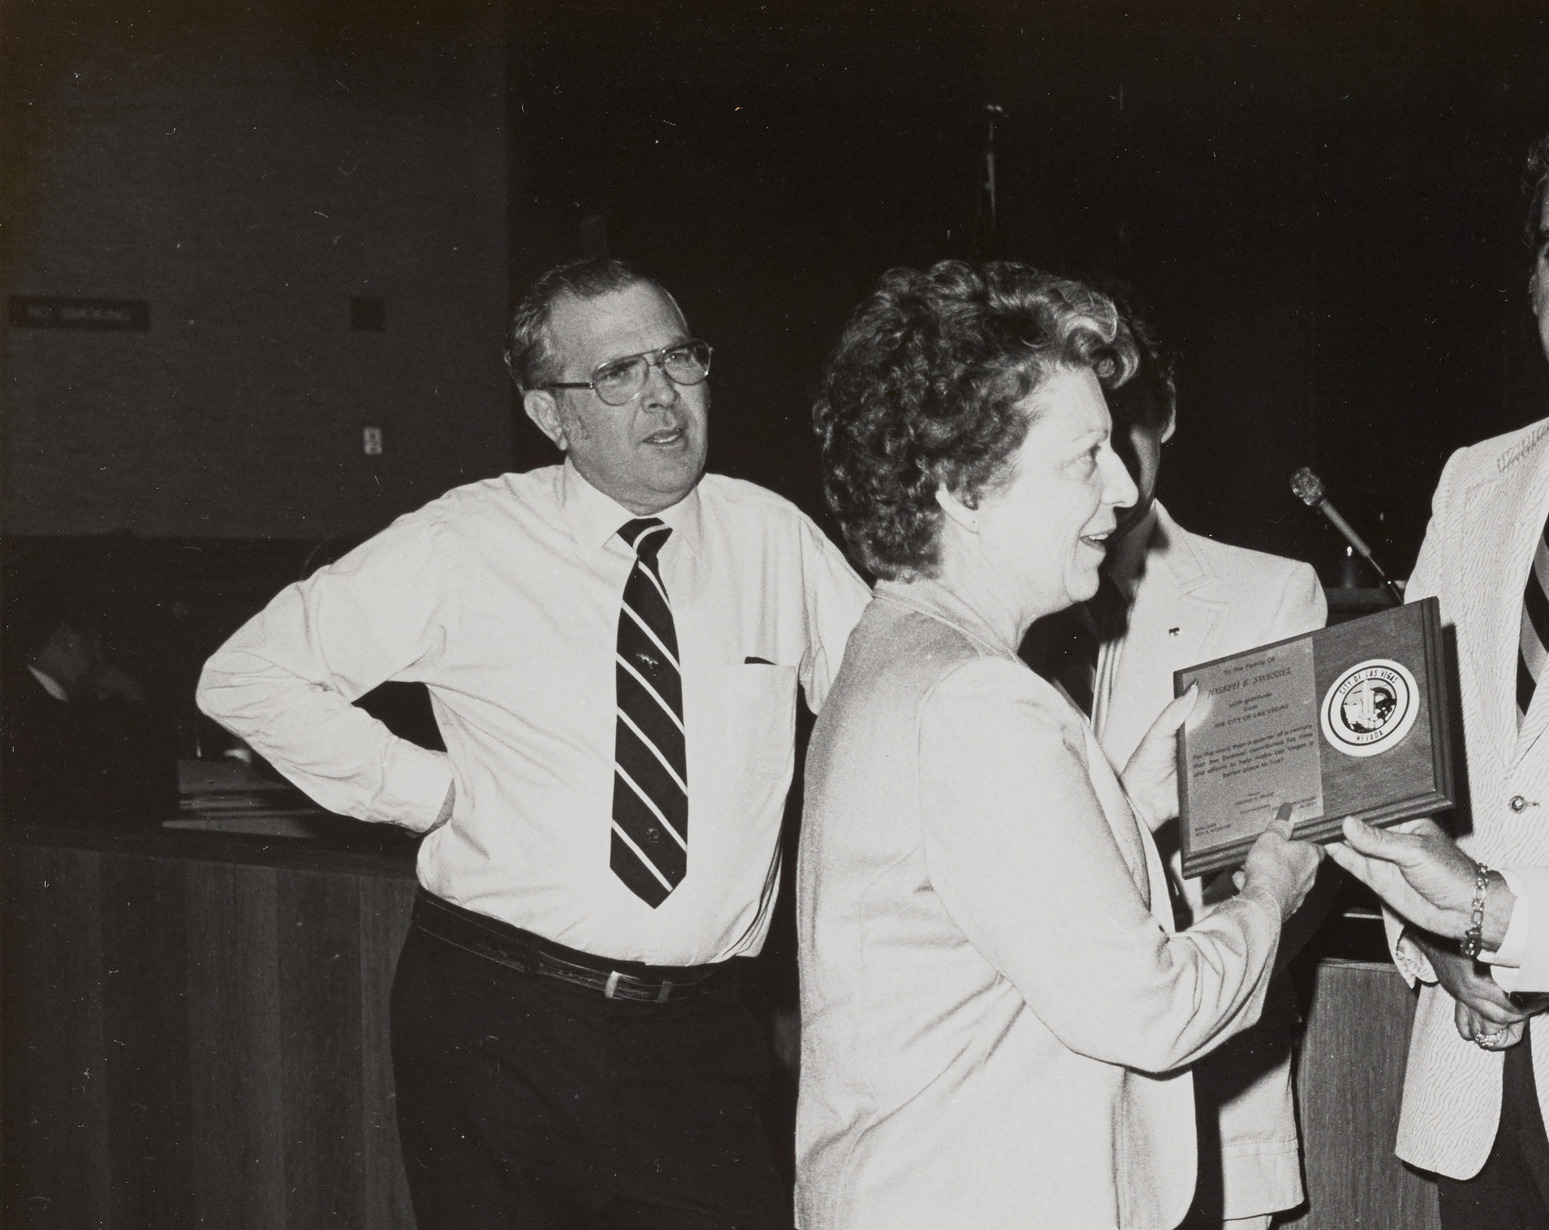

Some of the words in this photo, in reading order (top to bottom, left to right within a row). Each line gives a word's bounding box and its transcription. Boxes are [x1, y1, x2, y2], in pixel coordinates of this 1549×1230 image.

[1209, 682, 1240, 697] JOSEPH
[1339, 681, 1353, 696] CITY
[1353, 673, 1362, 683] OF
[1366, 669, 1378, 678] LAS
[1380, 671, 1399, 685] VEGAS
[1227, 718, 1241, 726] CITY
